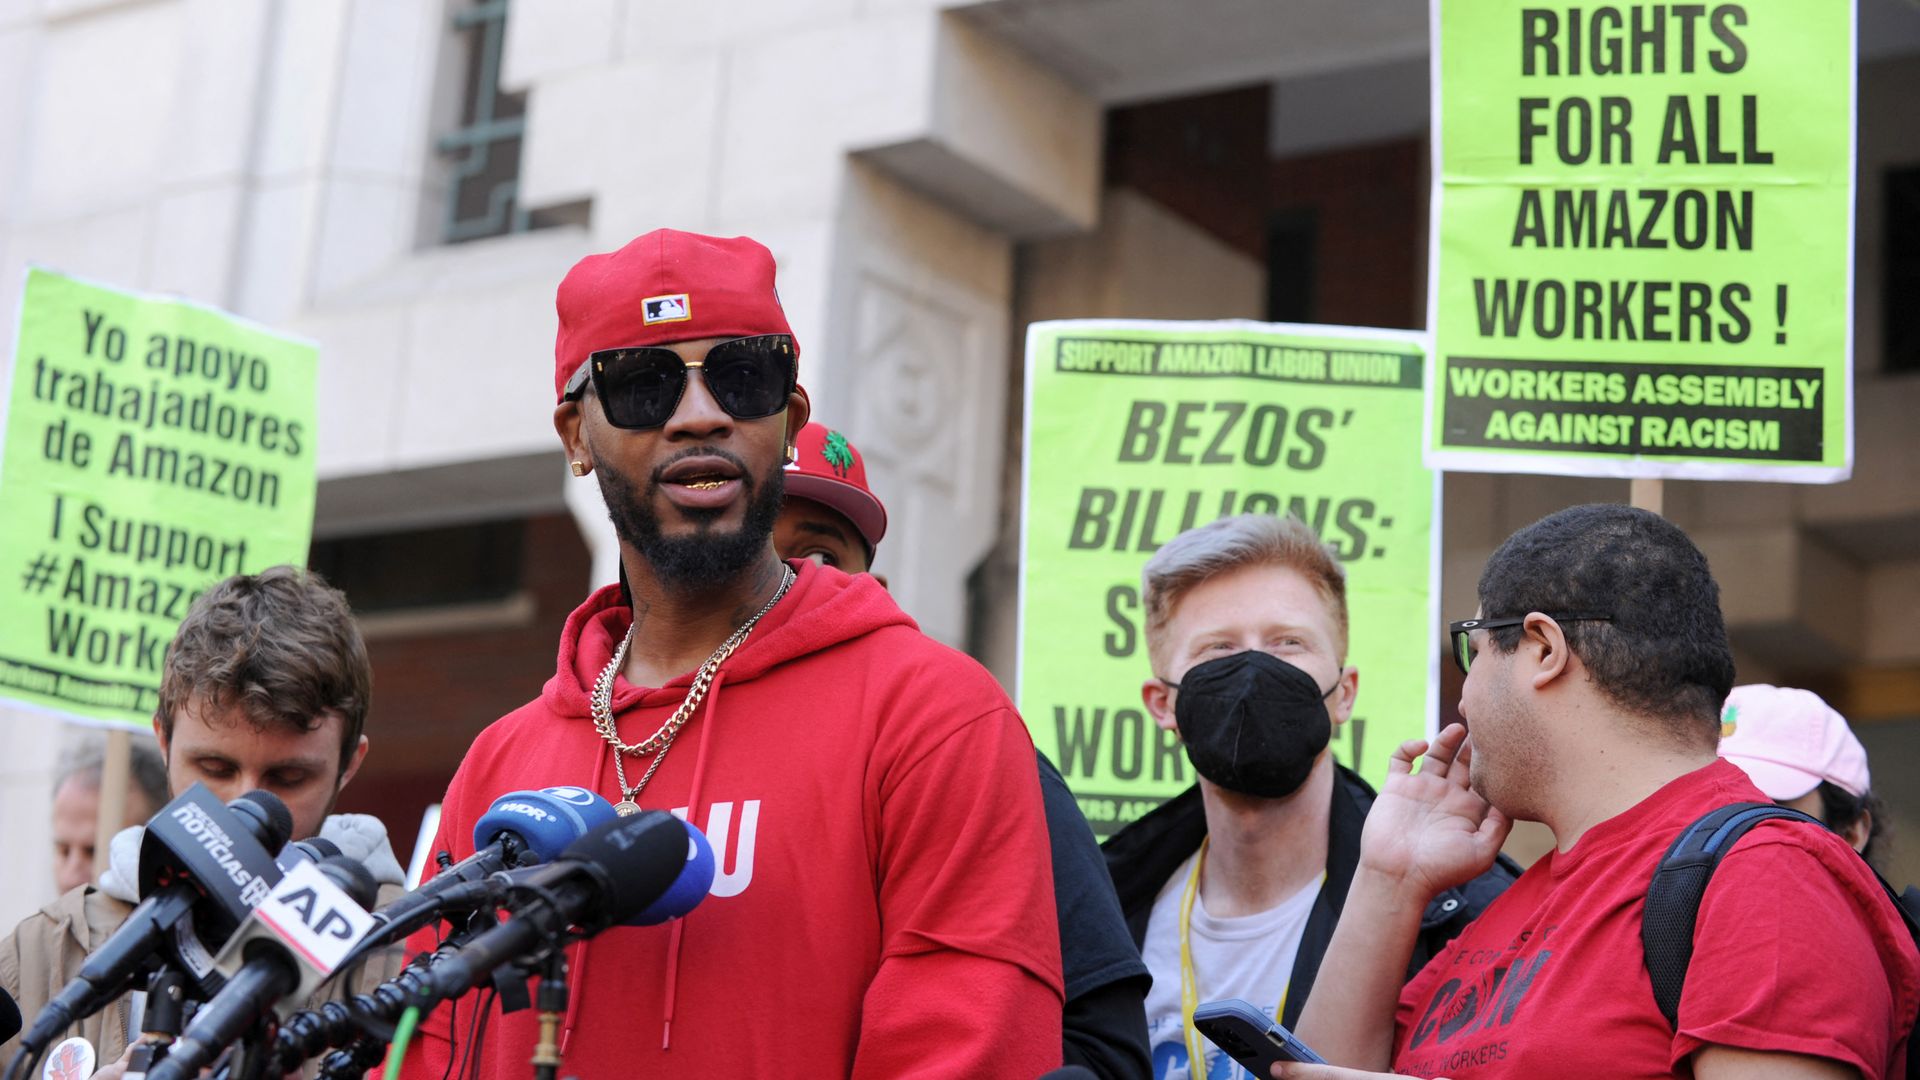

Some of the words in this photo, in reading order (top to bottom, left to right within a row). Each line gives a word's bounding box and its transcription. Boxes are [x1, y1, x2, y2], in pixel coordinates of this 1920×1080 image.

[1520, 4, 1749, 77] RIGHTS
[1518, 97, 1633, 166] FOR
[1657, 95, 1774, 165] ALL
[1511, 189, 1754, 251] AMAZON
[1473, 278, 1752, 344] WORKERS
[82, 310, 126, 364] Yo
[145, 331, 269, 392] apoyo
[1060, 340, 1156, 374] SUPPORT
[1157, 342, 1251, 375] AMAZON
[1255, 346, 1326, 380] LABOR
[1331, 351, 1400, 384] UNION
[34, 357, 304, 457] trabajadores
[1449, 367, 1627, 403] WORKERS
[1632, 374, 1821, 410] ASSEMBLY
[43, 418, 93, 470] de
[107, 433, 281, 508] Amazon
[1484, 411, 1635, 446] AGAINST
[1641, 417, 1780, 451] RACISM
[51, 492, 64, 540] I
[79, 504, 248, 576] Support
[22, 552, 201, 622] #Amaz
[47, 607, 170, 673] Work
[277, 887, 354, 940] AP
